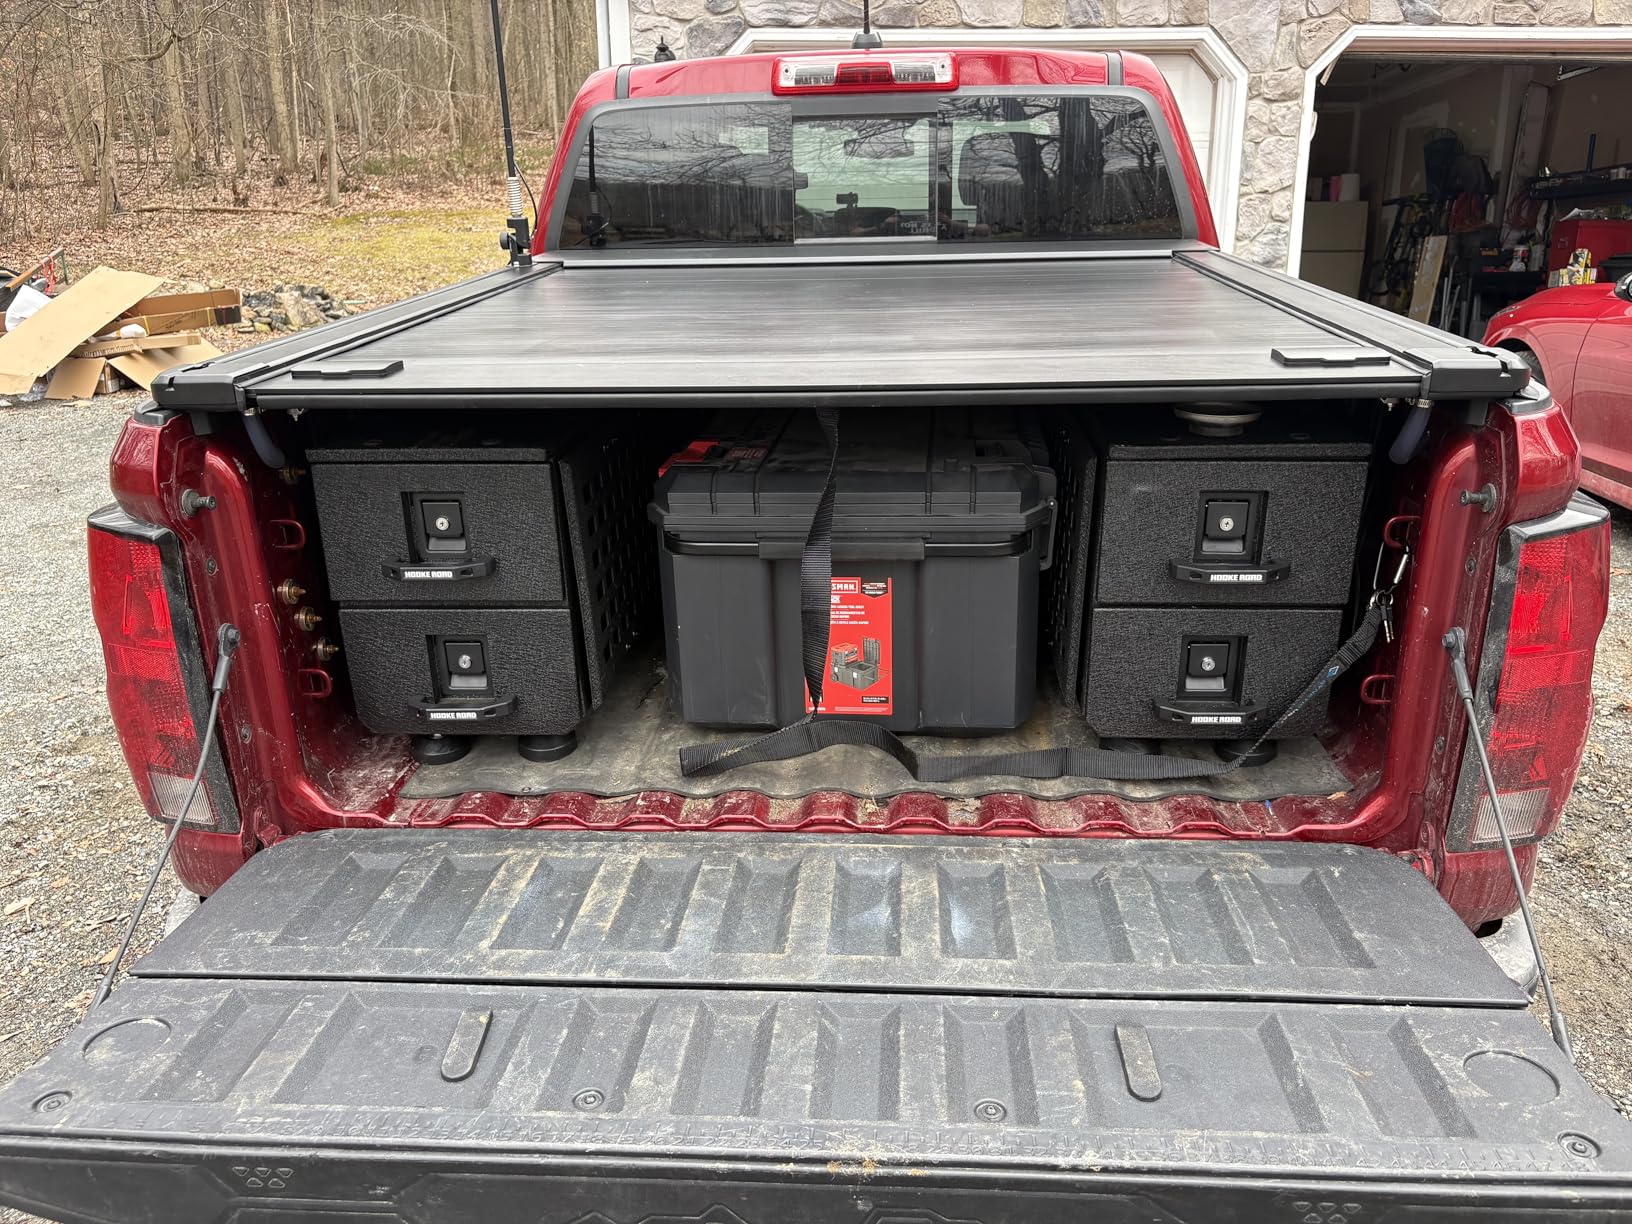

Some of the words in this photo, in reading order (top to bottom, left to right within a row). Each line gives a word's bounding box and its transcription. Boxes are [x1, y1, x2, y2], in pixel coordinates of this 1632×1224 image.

[404, 571, 430, 579] HOOKE
[431, 571, 453, 579] ROAD
[1210, 574, 1238, 582] HOOKE
[1239, 574, 1263, 582] ROAD
[430, 712, 455, 720] HOOKE
[1192, 716, 1219, 724] HOOKE
